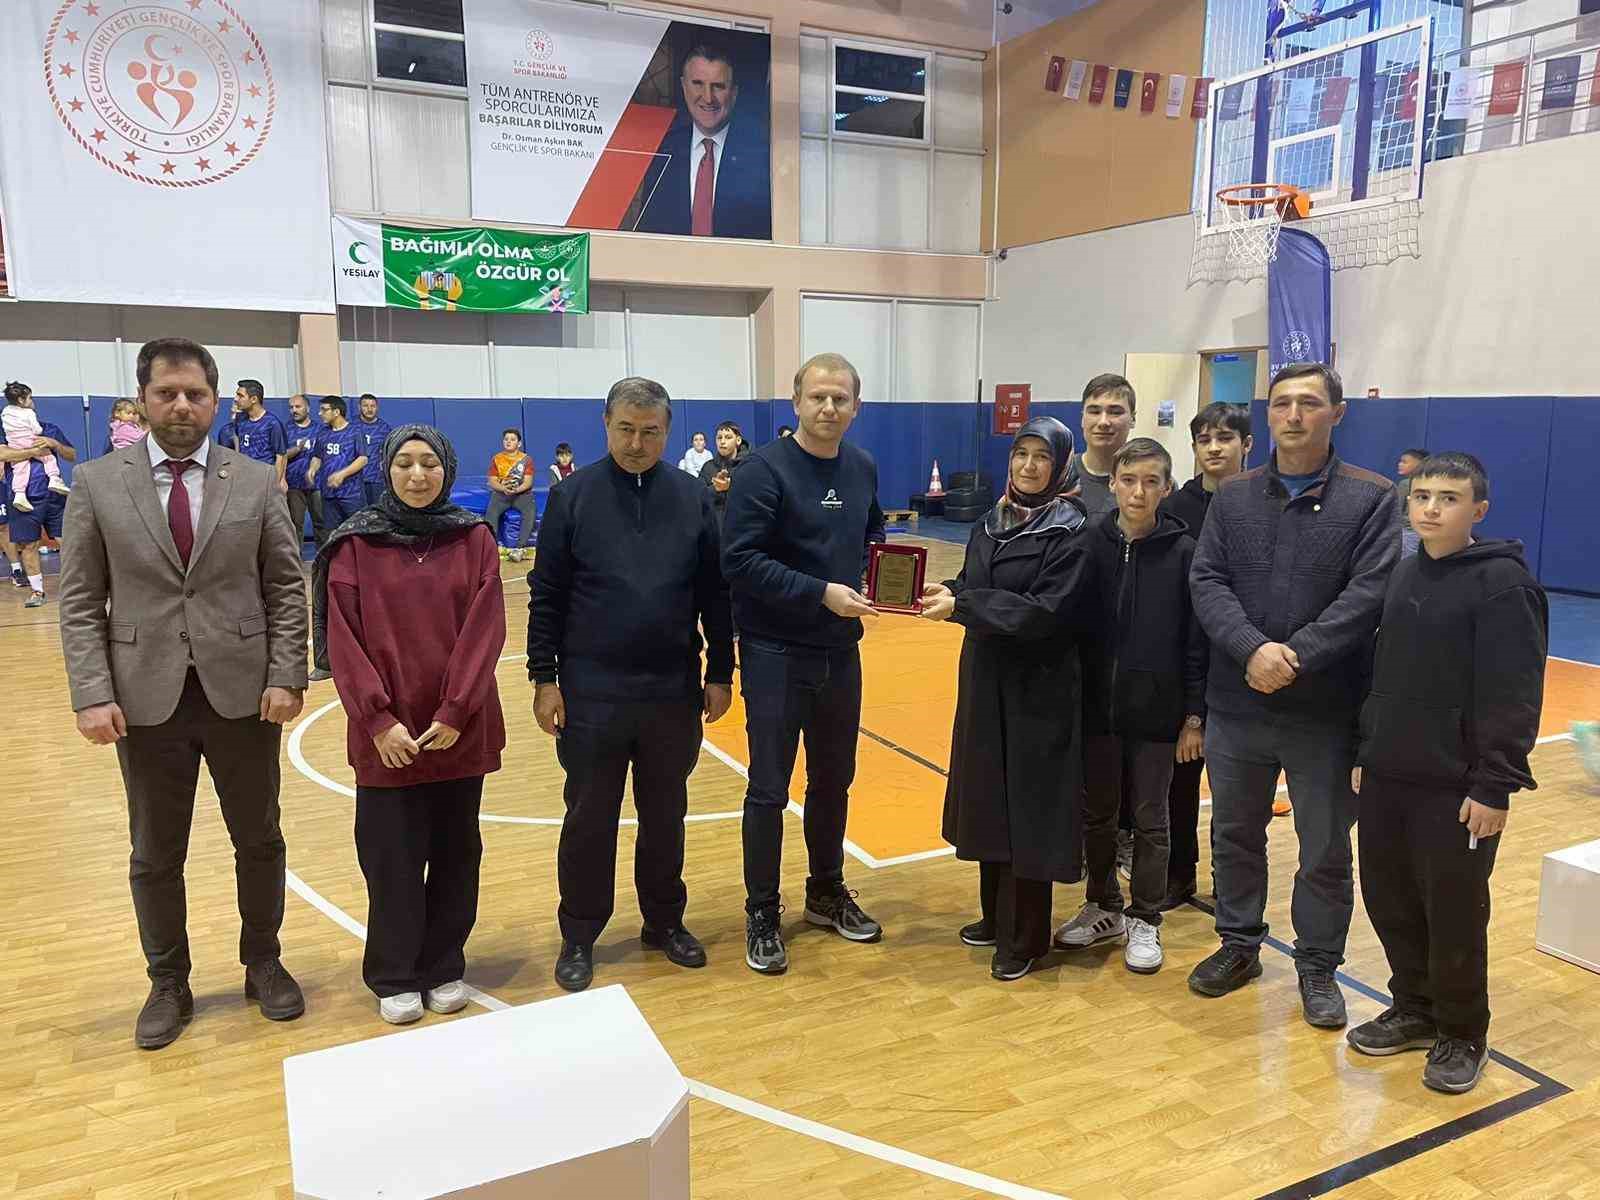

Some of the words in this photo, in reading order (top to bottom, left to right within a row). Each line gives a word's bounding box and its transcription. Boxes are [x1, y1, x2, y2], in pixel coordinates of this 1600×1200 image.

[139, 11, 201, 38] GENÇLİK
[88, 14, 136, 94] CUMHURİYETİ
[200, 34, 219, 53] VE
[216, 53, 234, 90] SPOR
[480, 81, 510, 98] TÜM
[513, 87, 582, 106] ANTRENÖR
[584, 95, 599, 108] VE
[97, 96, 148, 144] TÜRKİYE
[185, 93, 235, 147] BAKANLIĞI
[484, 98, 597, 121] SPORCULARIMIZA
[479, 113, 541, 128] BAŞARILAR
[543, 119, 603, 135] DİLİYORUM
[490, 142, 527, 154] GENÇLİK
[528, 144, 540, 154] VE
[540, 145, 562, 157] SPOR
[564, 148, 595, 160] BAKANI
[502, 132, 514, 141] Dr.
[515, 133, 542, 143] Osman
[567, 138, 583, 147] BAK
[390, 235, 473, 257] BAĞIMLI
[478, 243, 534, 260] OLMA
[475, 261, 541, 281] ÖZGÜR
[546, 267, 571, 282] OL
[326, 442, 340, 455] 58
